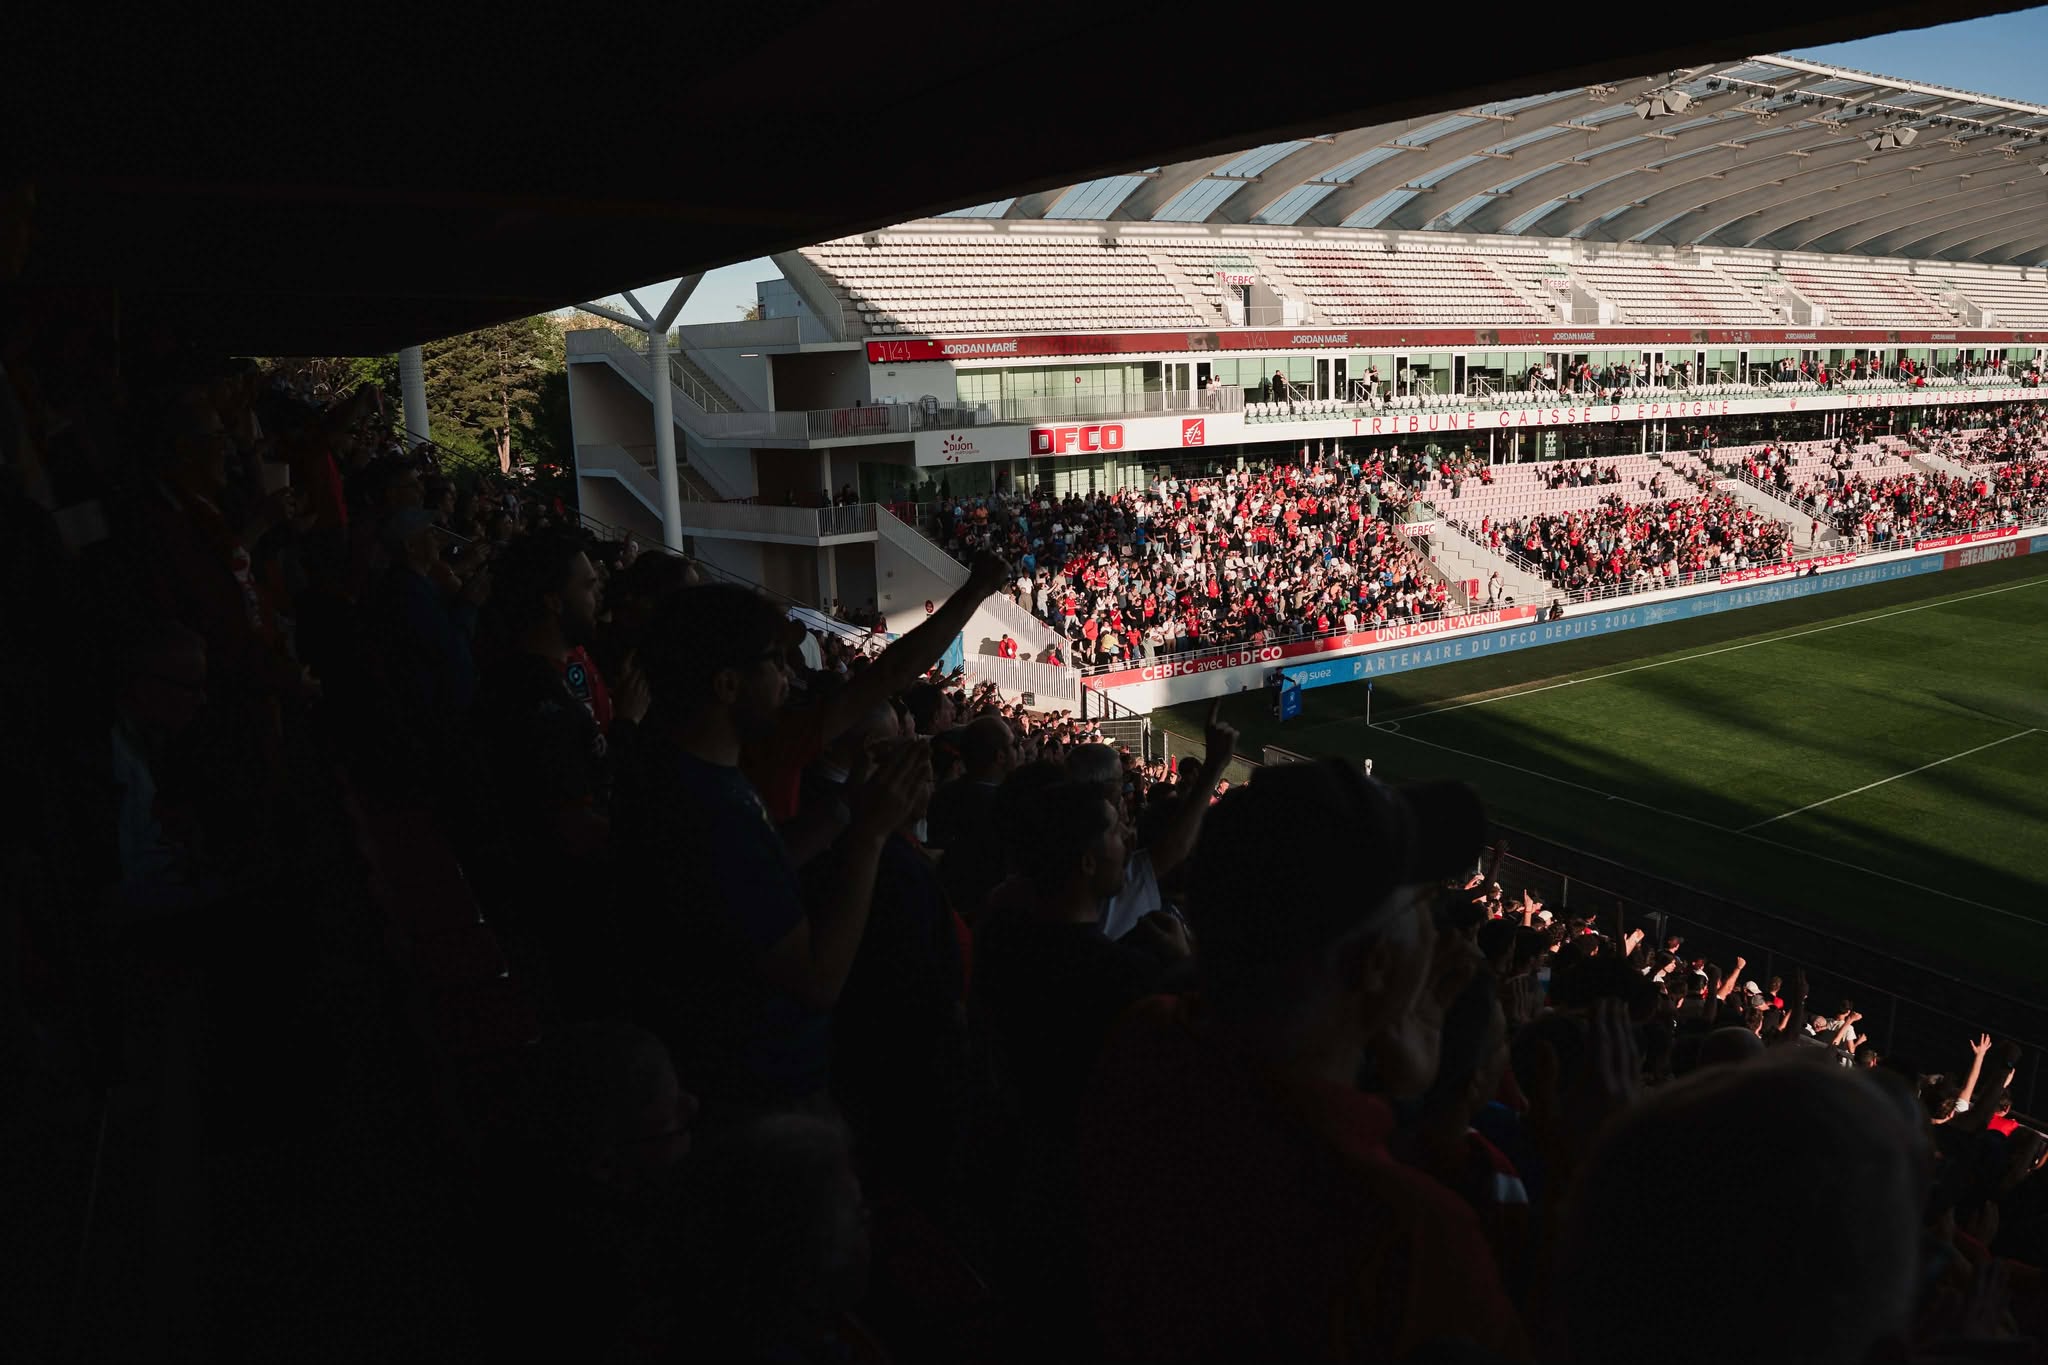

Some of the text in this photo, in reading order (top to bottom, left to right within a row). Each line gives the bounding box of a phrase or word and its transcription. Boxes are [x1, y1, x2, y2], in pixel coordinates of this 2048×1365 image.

[941, 344, 985, 355] JORDAN
[986, 339, 1018, 353] MARIÉ
[1291, 332, 1349, 344] JORDAN MARIÉ
[1847, 393, 1913, 408] TRIBUNE
[1925, 390, 1977, 404] CAISSE
[1352, 400, 1729, 435] TRIBUNE CAISSE D EPARGNE
[1029, 423, 1125, 457] DFCO
[1406, 524, 1435, 537] CEBFC
[1960, 542, 2017, 566] #TEAMDFCO
[1376, 611, 1501, 642] UNIS POUR L'AVENIR
[1354, 614, 1636, 674] PARTENAIRE DU DFCO DEPUIS 2004
[1142, 646, 1283, 680] CEBFC avec le DFCO
[1310, 668, 1331, 680] suez
